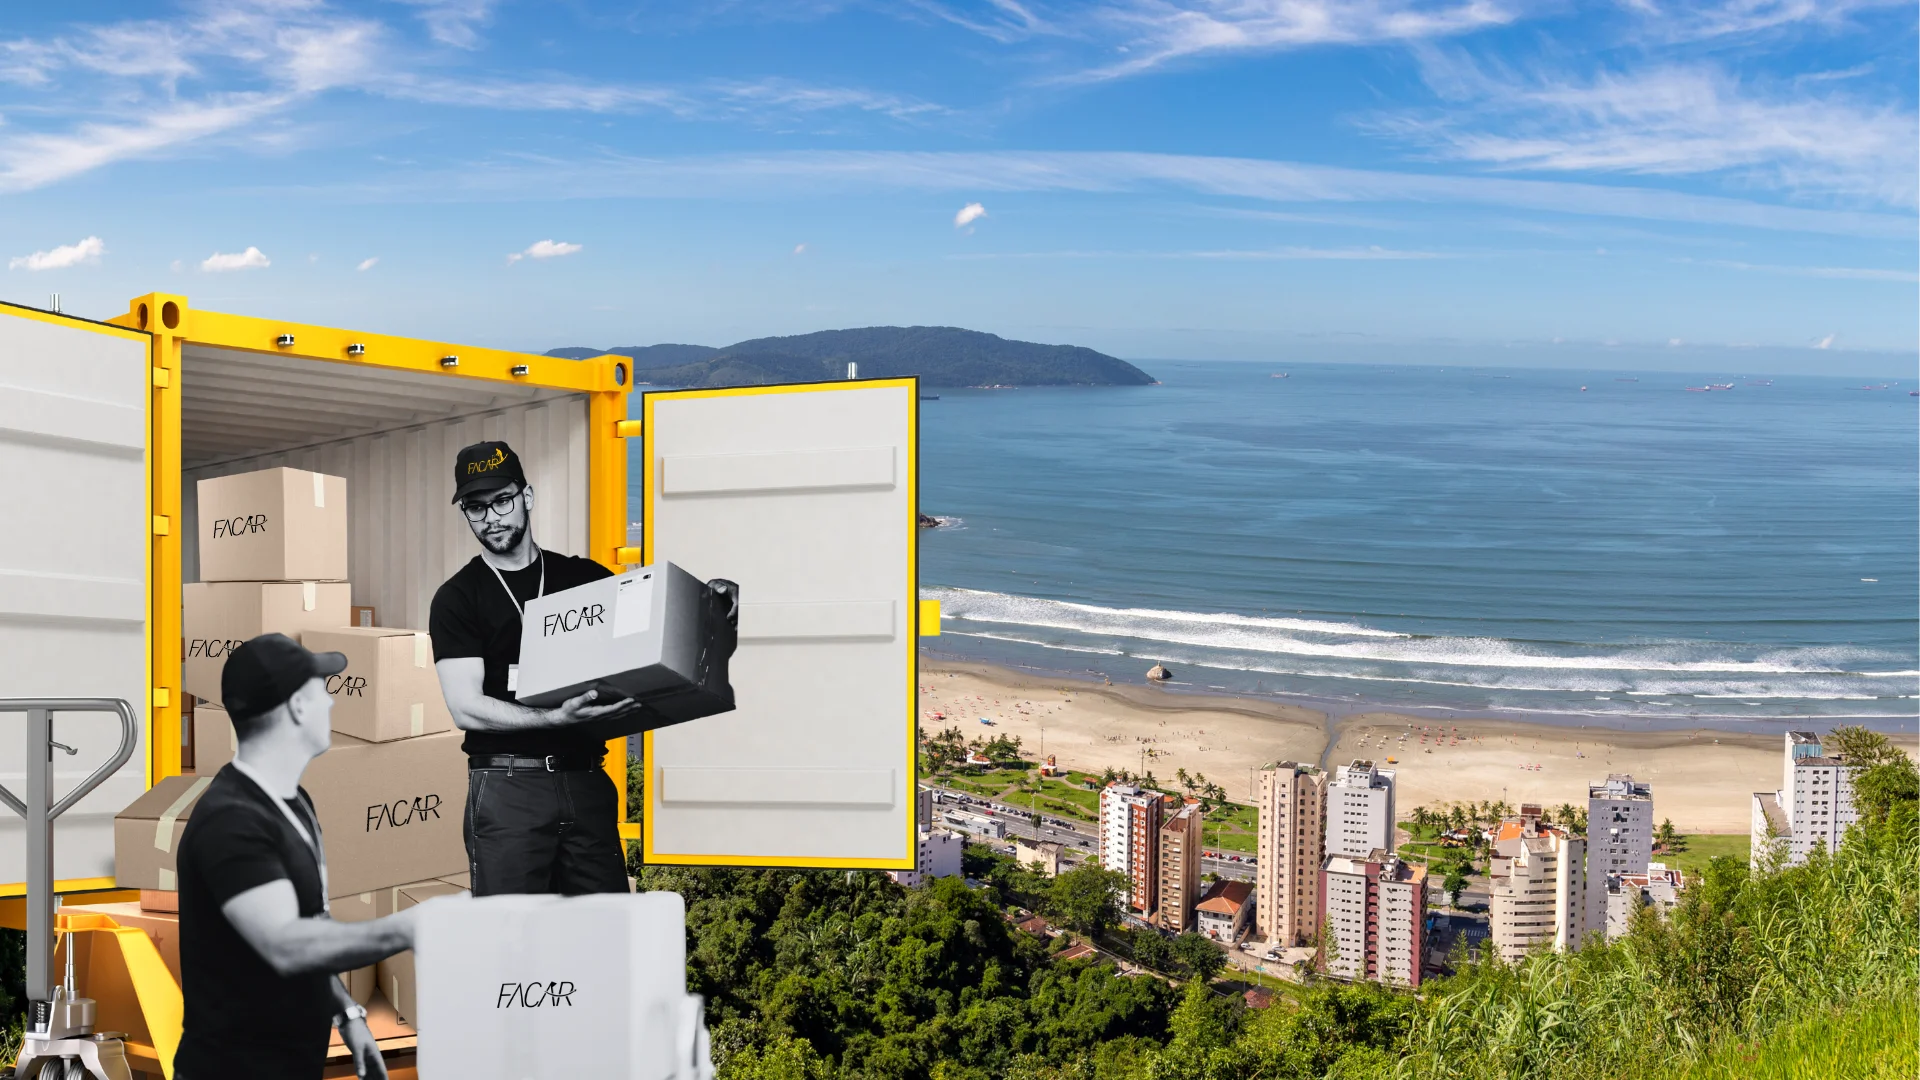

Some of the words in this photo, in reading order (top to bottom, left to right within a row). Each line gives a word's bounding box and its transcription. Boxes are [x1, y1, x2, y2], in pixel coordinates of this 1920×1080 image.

[467, 453, 503, 474] FACAR
[213, 514, 268, 538] FACAR
[544, 603, 606, 637] FACAR
[325, 674, 368, 698] CAR
[366, 794, 443, 833] FACAR
[496, 981, 577, 1009] FACAR
